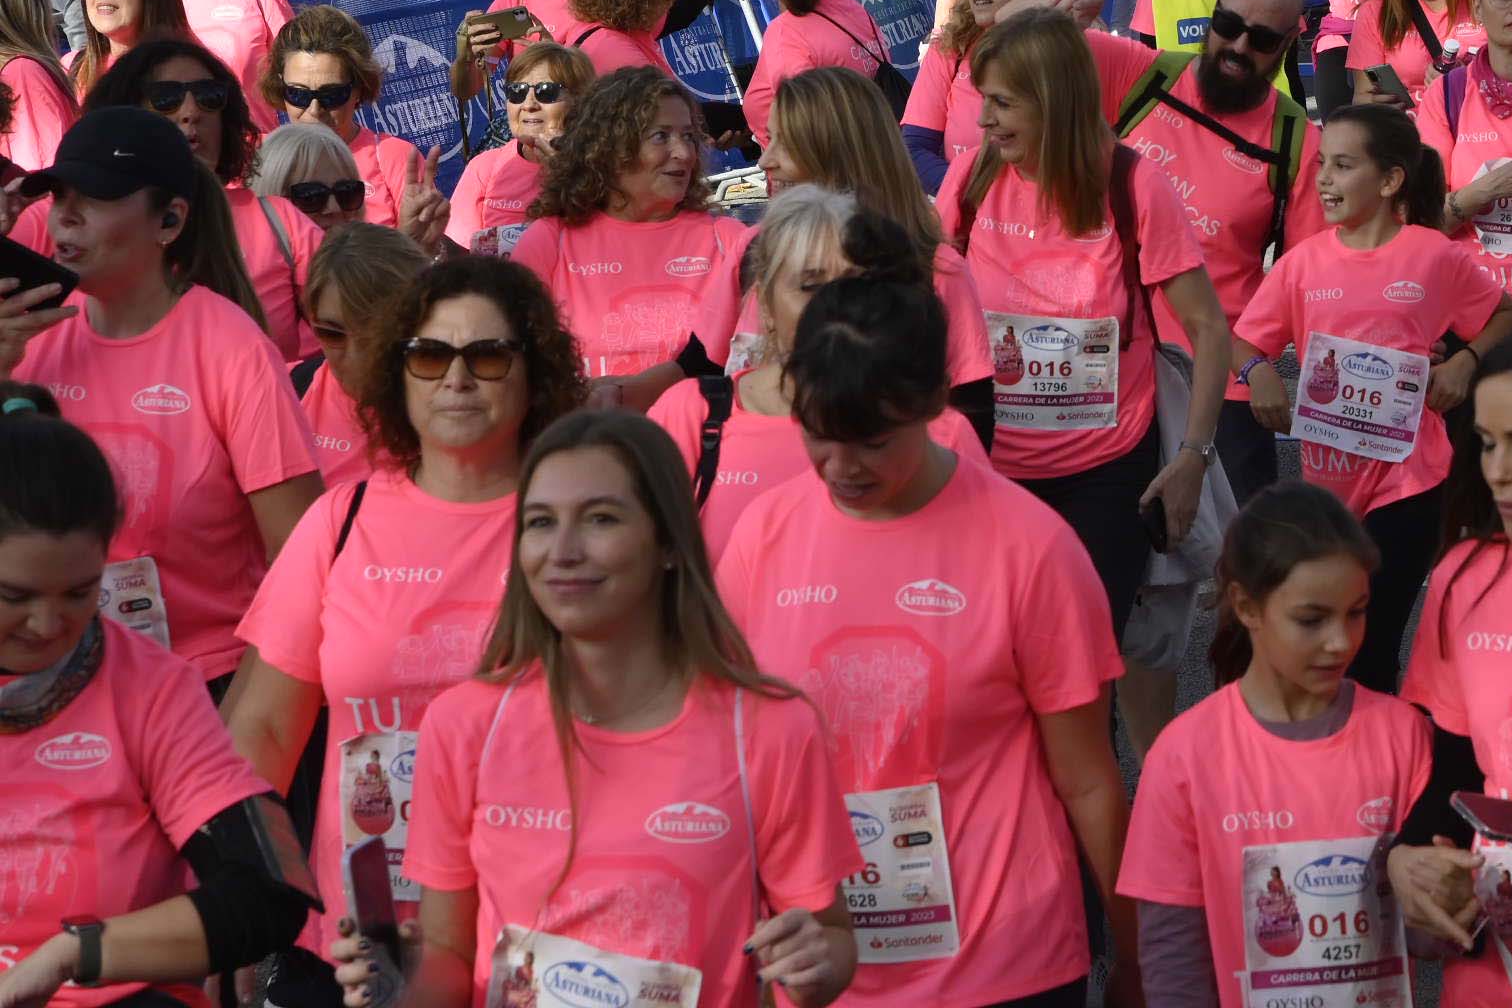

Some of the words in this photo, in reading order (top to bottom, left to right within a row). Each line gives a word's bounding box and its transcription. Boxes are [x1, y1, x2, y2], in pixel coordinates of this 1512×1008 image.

[1179, 25, 1205, 39] VOL
[1153, 106, 1184, 129] SHO
[1132, 137, 1178, 168] HOY
[1027, 332, 1075, 345] ASTURIANA
[1028, 360, 1073, 377] 016
[1347, 359, 1391, 377] ASTURIANA
[1032, 382, 1068, 392] 13796
[1342, 384, 1382, 406] 016
[998, 395, 1033, 404] CARRERA
[1035, 396, 1047, 404] DE
[1047, 396, 1057, 404] LA
[1060, 396, 1085, 404] MUJER
[1067, 412, 1106, 421] Santander
[1310, 410, 1341, 424] CARRERA
[1342, 419, 1353, 427] DE
[1353, 421, 1363, 429] LA
[1342, 405, 1373, 420] 20331
[1304, 423, 1339, 440] OYSHO
[1368, 439, 1405, 454] Santander
[715, 469, 758, 487] SHO
[364, 564, 443, 584] OYSHO
[344, 697, 402, 734] TU
[854, 916, 867, 924] LA
[869, 915, 905, 924] MUJER
[1309, 910, 1370, 938] 016
[884, 933, 943, 949] Santander
[1322, 944, 1361, 961] 4257
[1270, 971, 1321, 984] CARRERA
[1323, 969, 1339, 980] DE
[1341, 968, 1356, 978] LA
